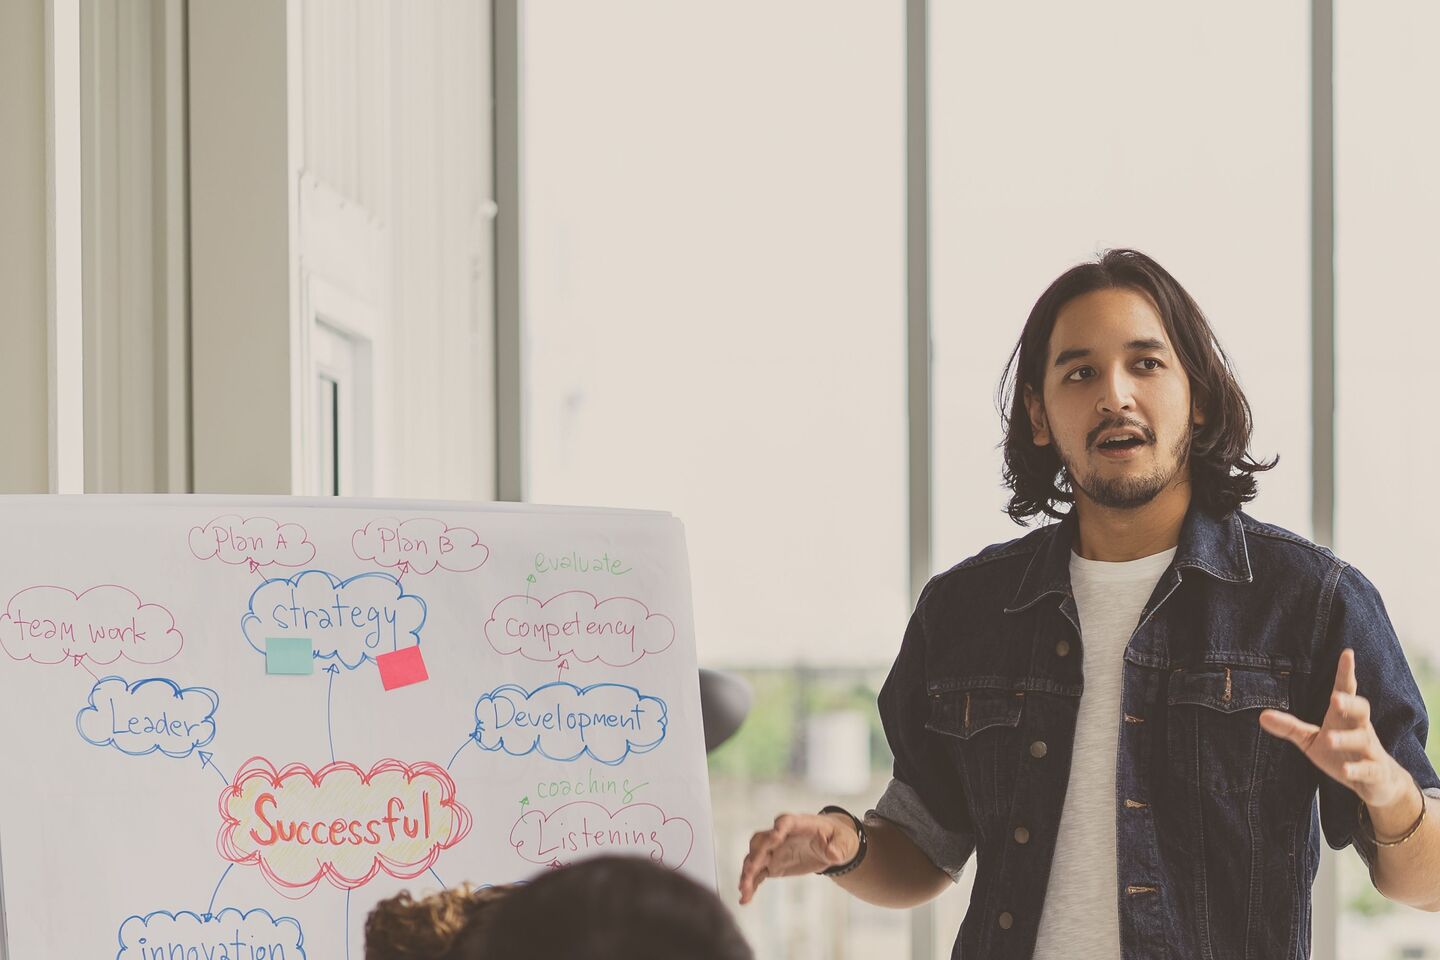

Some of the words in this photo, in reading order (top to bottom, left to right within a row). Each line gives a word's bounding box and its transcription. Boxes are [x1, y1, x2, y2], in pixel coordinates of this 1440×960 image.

[213, 526, 263, 551] Plan
[276, 534, 288, 550] A
[377, 527, 427, 555] Plan
[439, 536, 454, 555] B
[534, 552, 633, 575] evaluate
[13, 609, 75, 641] team
[110, 698, 200, 737] Leader
[494, 695, 646, 742] Development
[537, 768, 649, 804] coaching
[250, 790, 429, 846] Successful
[537, 818, 664, 863] Listening
